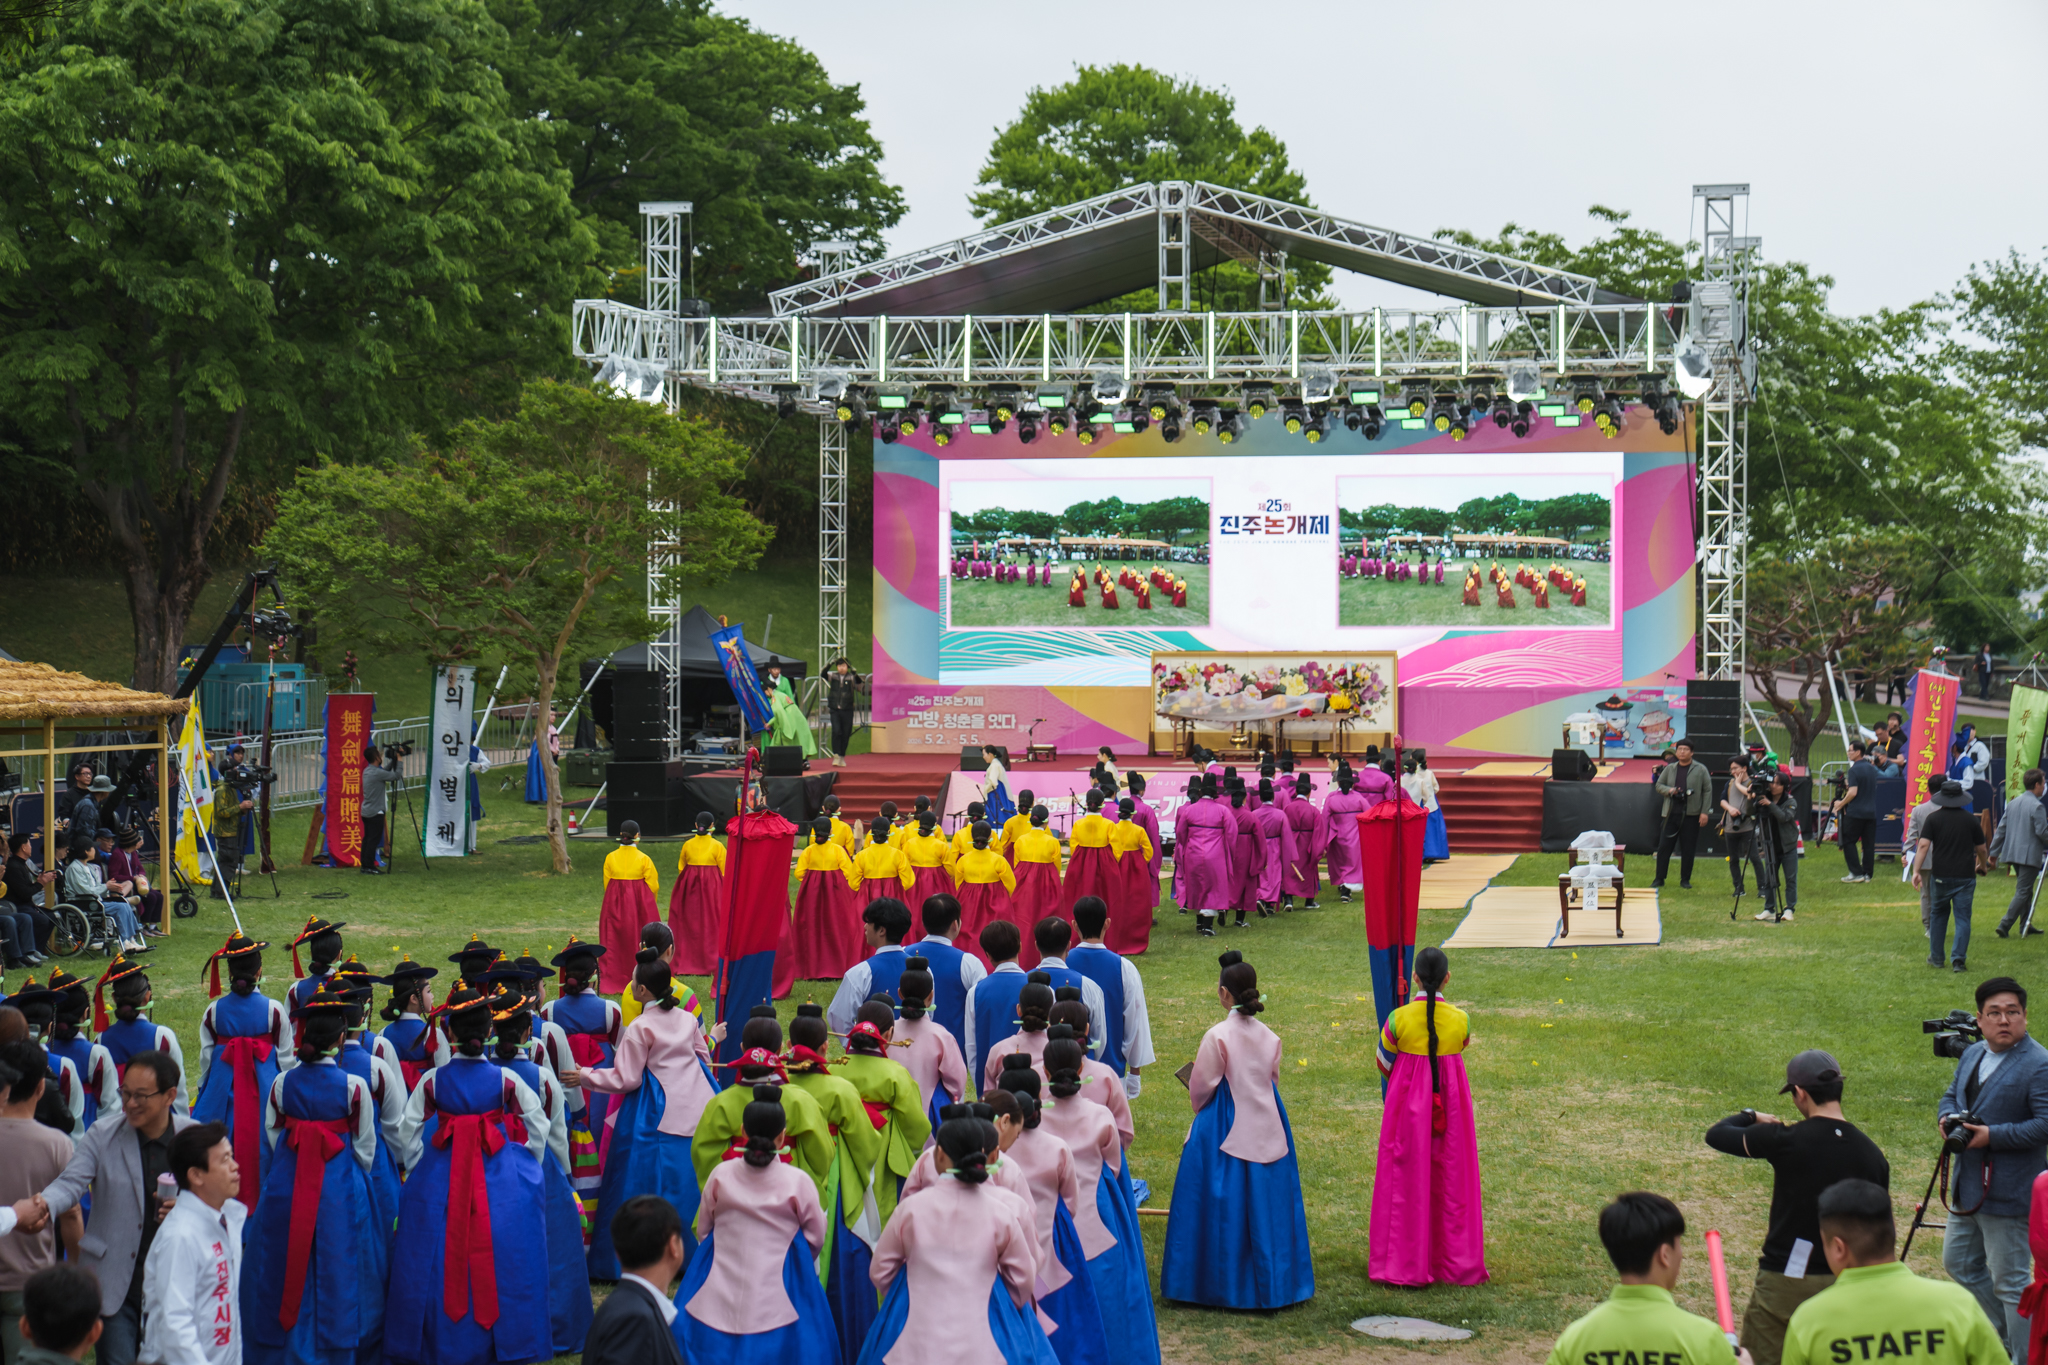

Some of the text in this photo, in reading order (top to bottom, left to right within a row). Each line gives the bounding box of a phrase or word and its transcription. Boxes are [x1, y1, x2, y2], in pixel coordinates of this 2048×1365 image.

[1258, 499, 1291, 512] 제25회
[1220, 515, 1330, 535] 진주논개제
[908, 695, 984, 706] 제25회 진주논개제
[435, 684, 464, 845] 의암별제
[1905, 682, 1946, 838] (사)진주민속예술보
[211, 1259, 231, 1347] 진주시장
[1583, 1350, 1682, 1365] STAFF
[1830, 1328, 1945, 1364] STAFF
